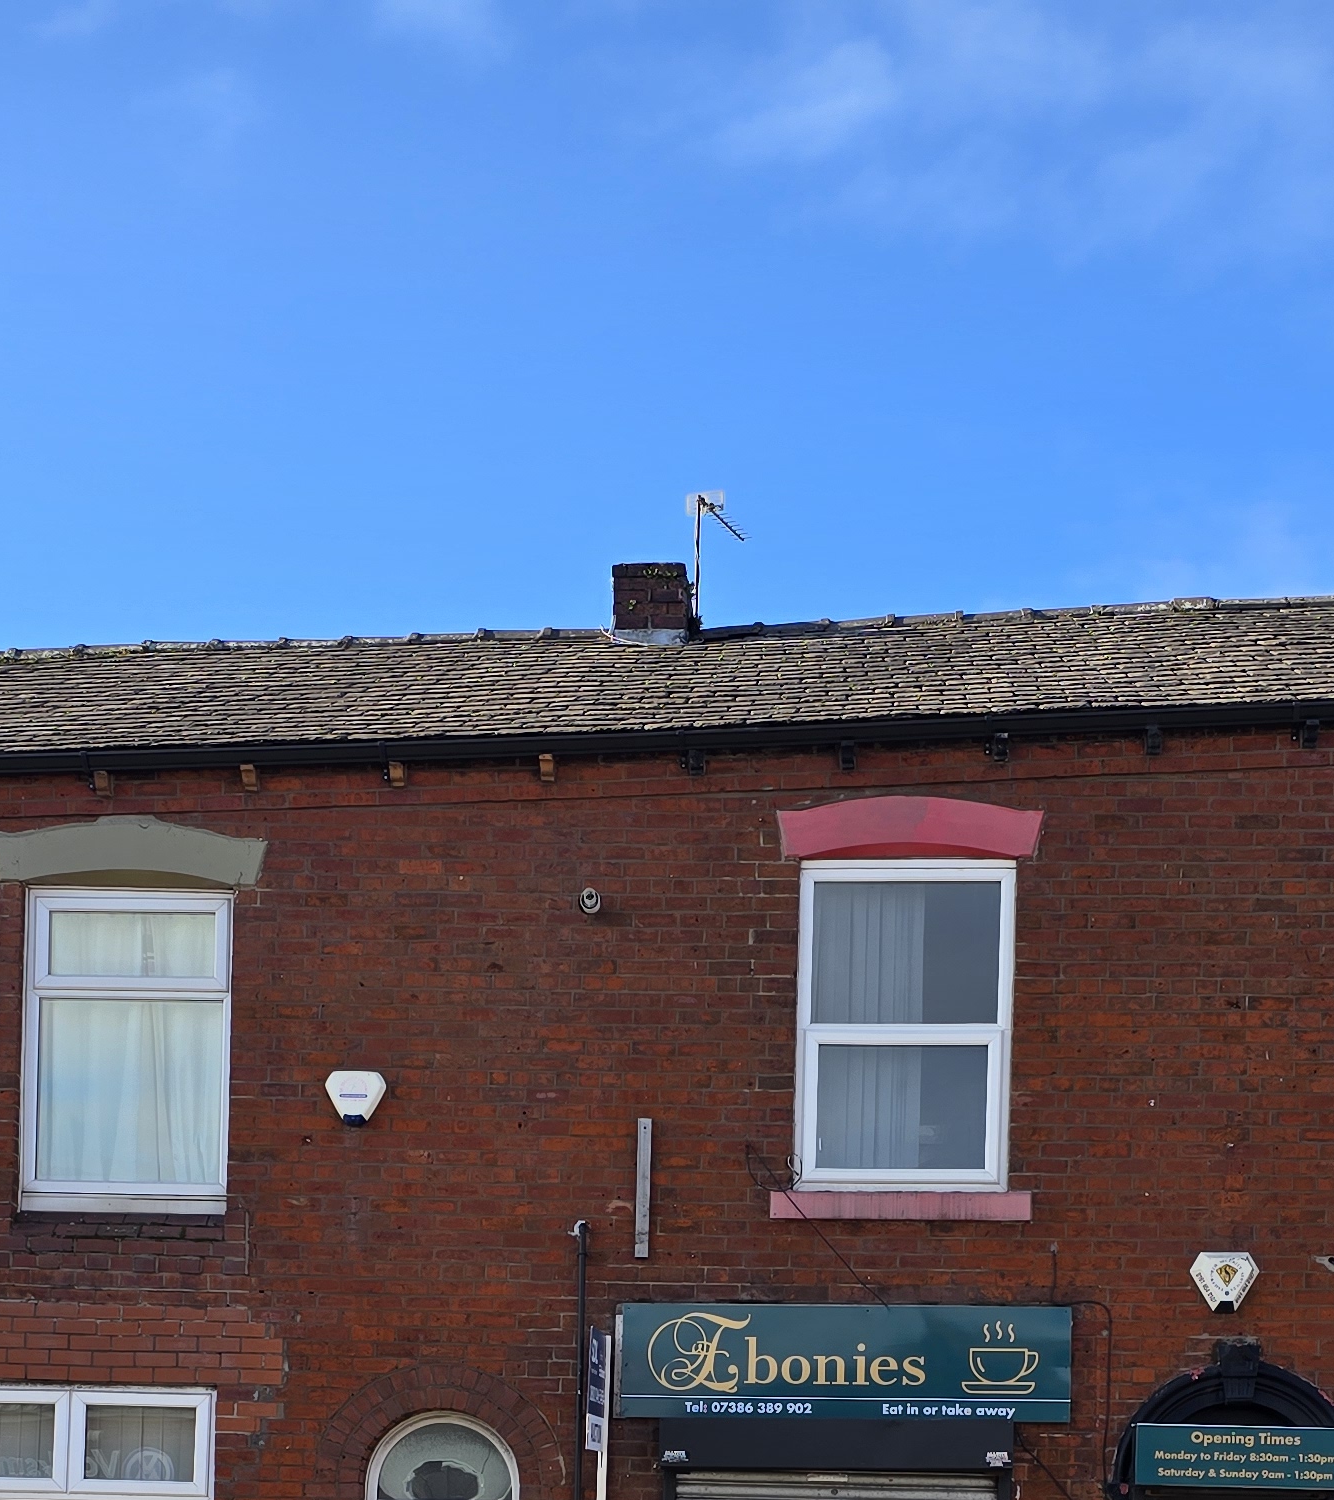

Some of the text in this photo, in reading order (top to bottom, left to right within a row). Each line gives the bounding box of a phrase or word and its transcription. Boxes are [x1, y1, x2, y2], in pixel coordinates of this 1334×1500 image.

[647, 1312, 926, 1393] Ebonies
[685, 1401, 813, 1415] Tel: 07386 389 902
[882, 1403, 1015, 1420] Eat in or take away
[1190, 1431, 1301, 1447] Opening Times
[1154, 1450, 1198, 1462] Monday
[1200, 1452, 1211, 1462] to
[1214, 1451, 1247, 1463] Friday
[1249, 1452, 1289, 1463] 8:30am
[1158, 1467, 1205, 1479] Saturday
[1208, 1468, 1216, 1478] &
[1219, 1468, 1265, 1480] Sunday
[1262, 1470, 1285, 1480] 9am
[1294, 1470, 1333, 1481] 1:30pm
